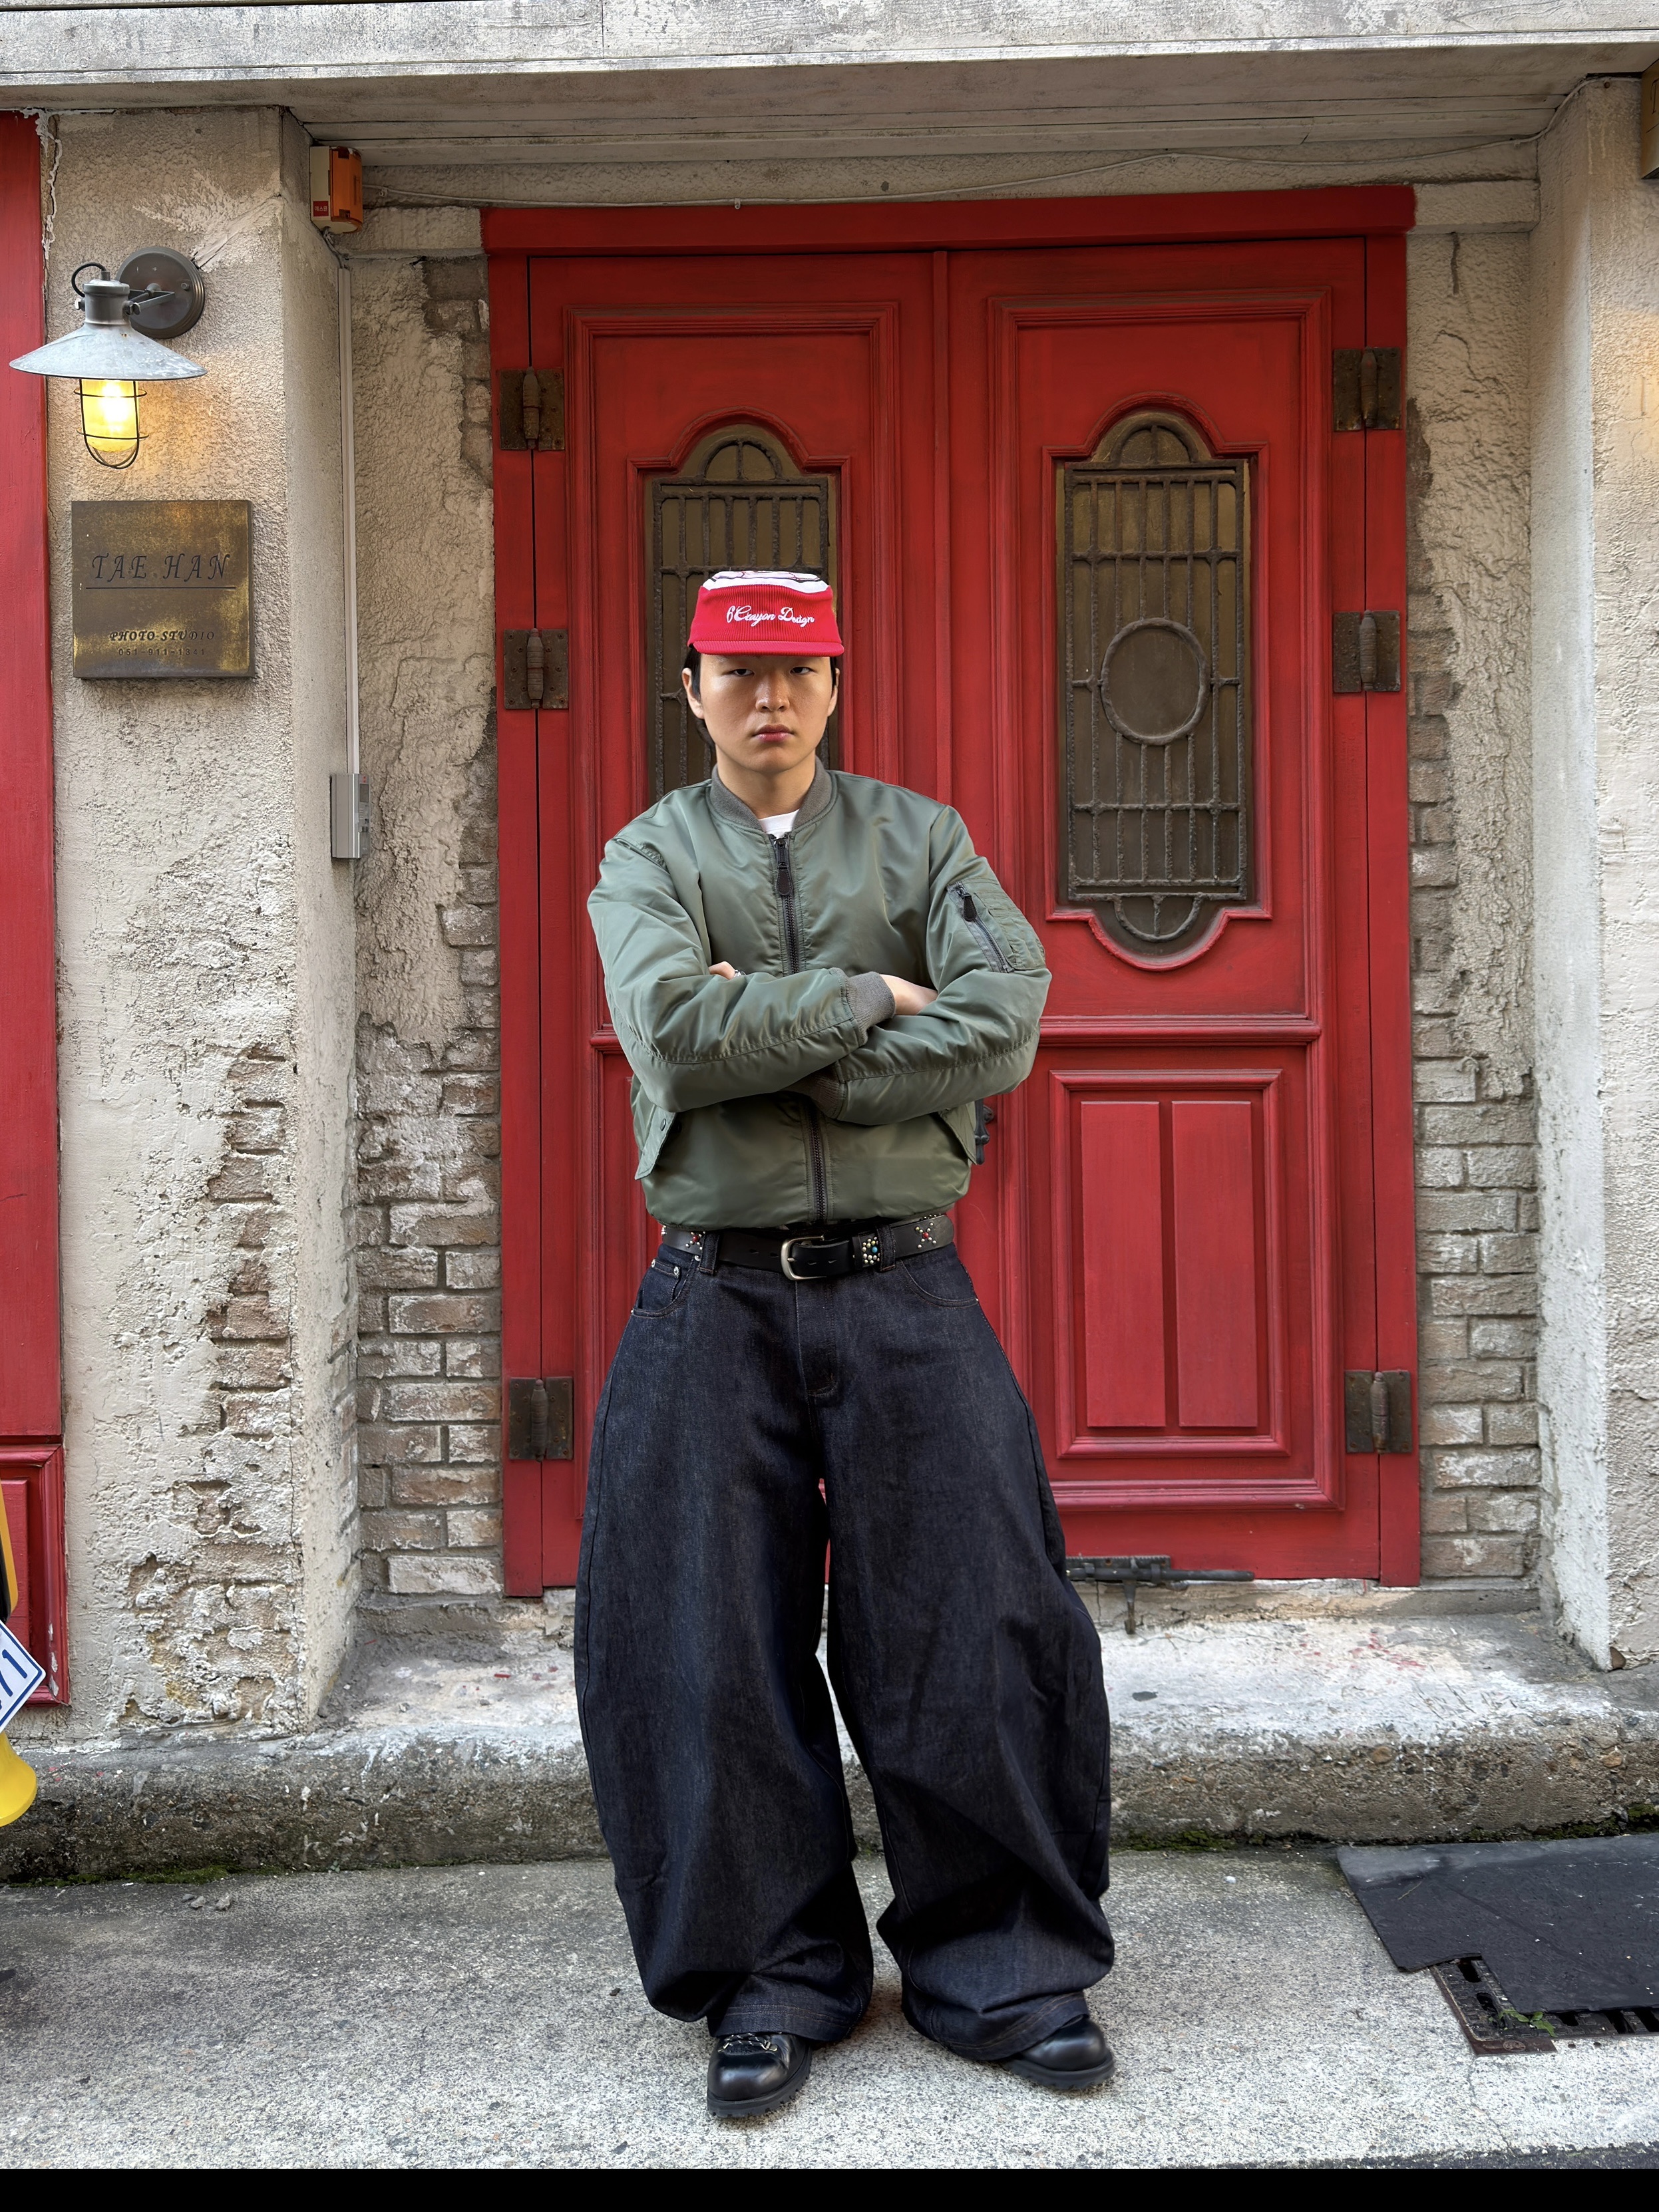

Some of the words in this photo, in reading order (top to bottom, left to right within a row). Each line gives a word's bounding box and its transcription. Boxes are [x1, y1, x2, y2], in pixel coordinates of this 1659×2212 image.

[92, 553, 147, 583] TAE
[162, 553, 230, 583] HAN
[110, 630, 156, 642] PHOTO
[161, 630, 215, 642] STUDIO
